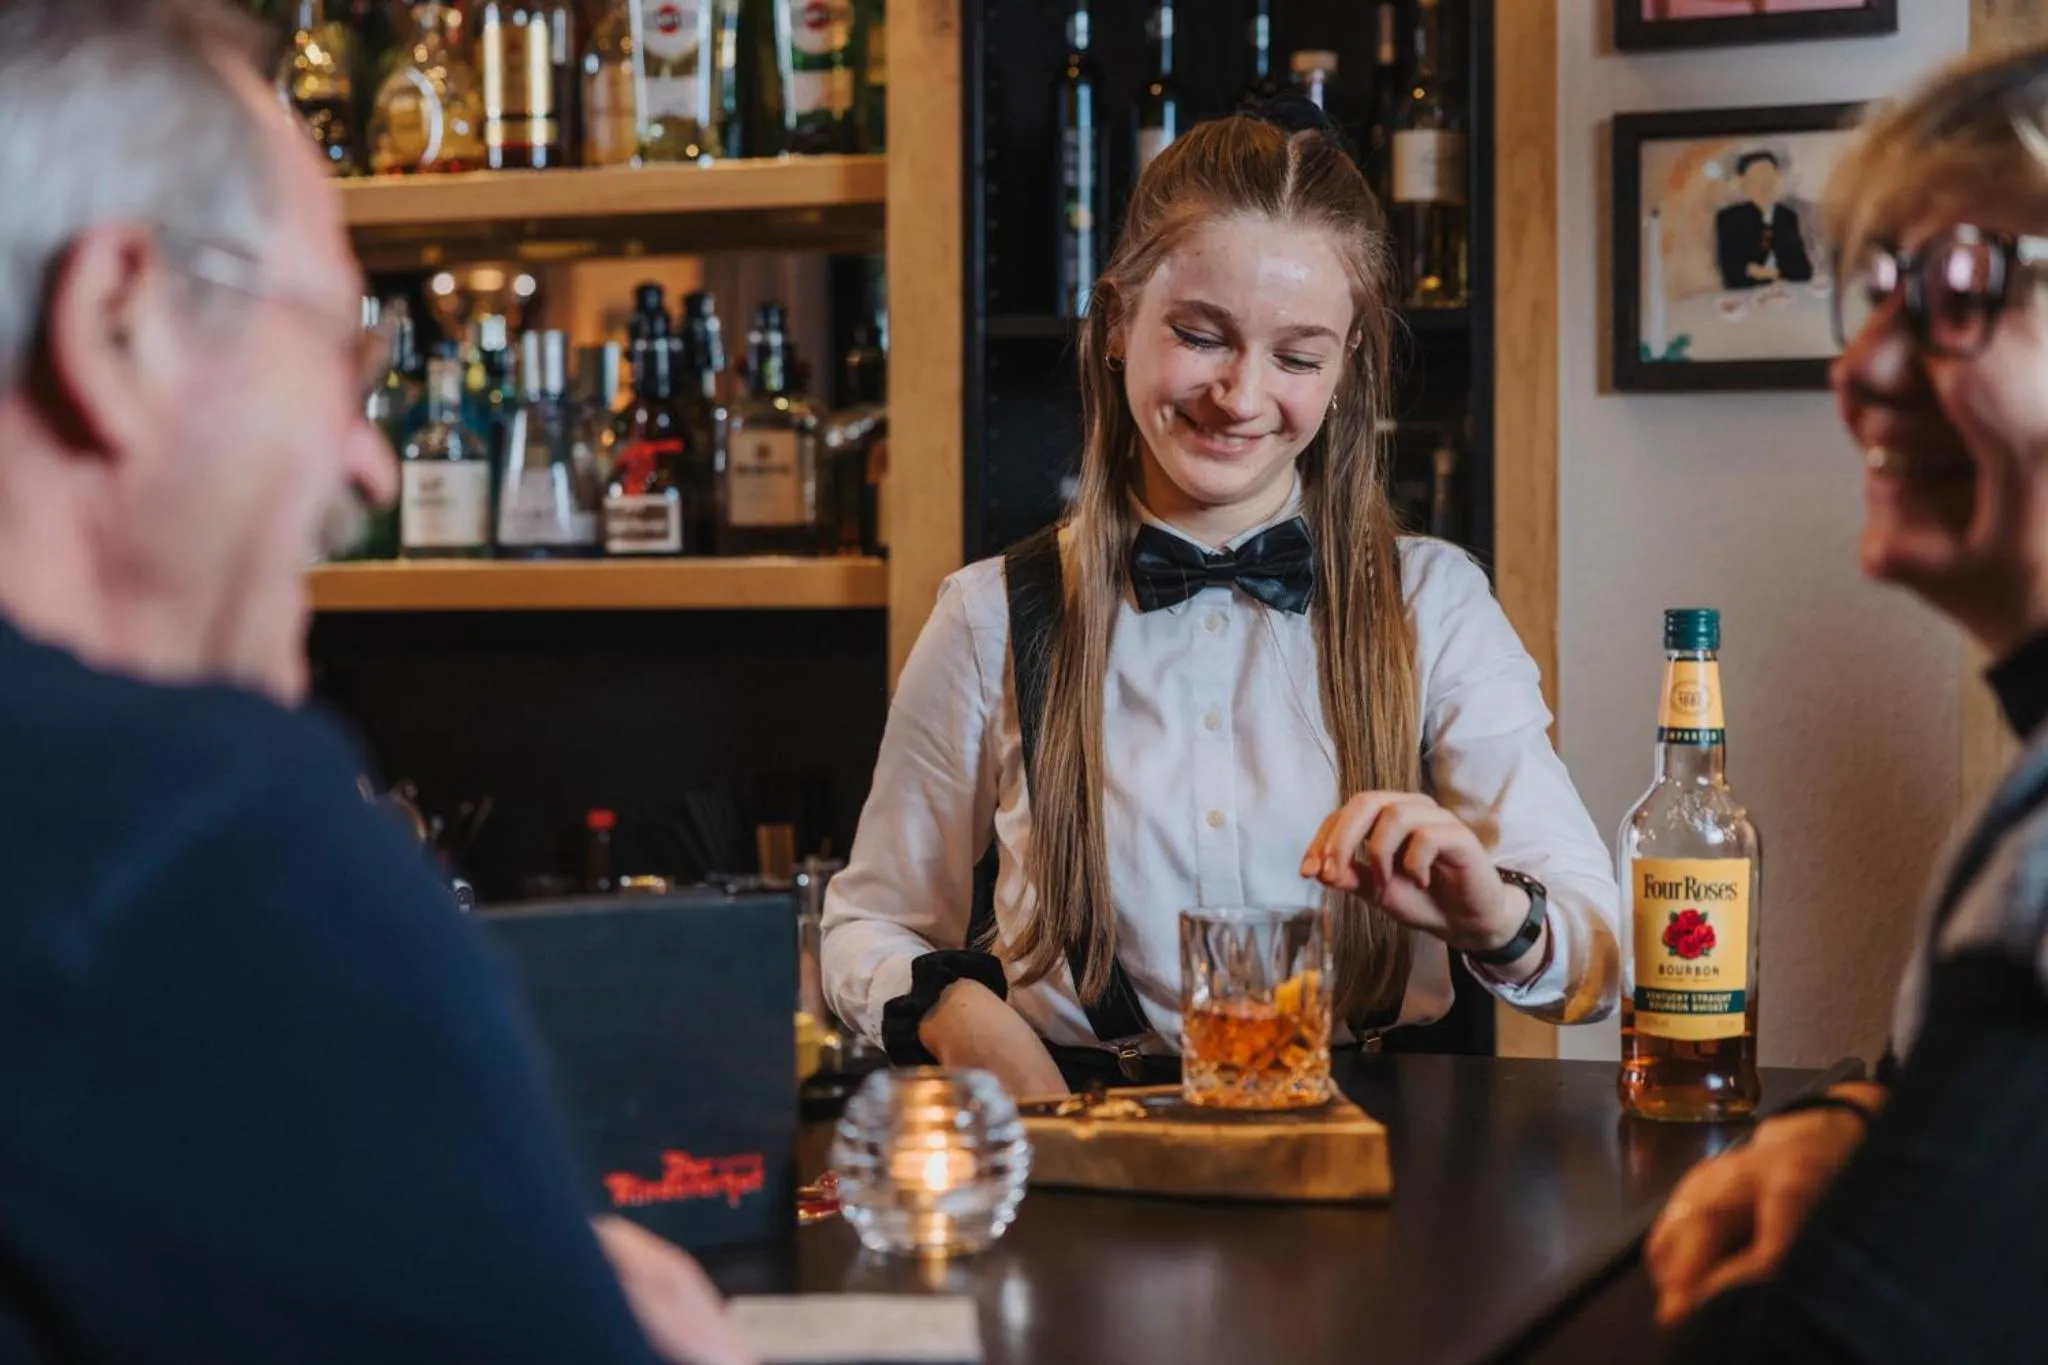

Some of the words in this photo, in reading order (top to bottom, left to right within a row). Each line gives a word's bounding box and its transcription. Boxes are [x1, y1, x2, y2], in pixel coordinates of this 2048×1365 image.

[1643, 873, 1683, 899] Four
[1684, 873, 1738, 901] Roses
[1658, 963, 1719, 976] BOURBON
